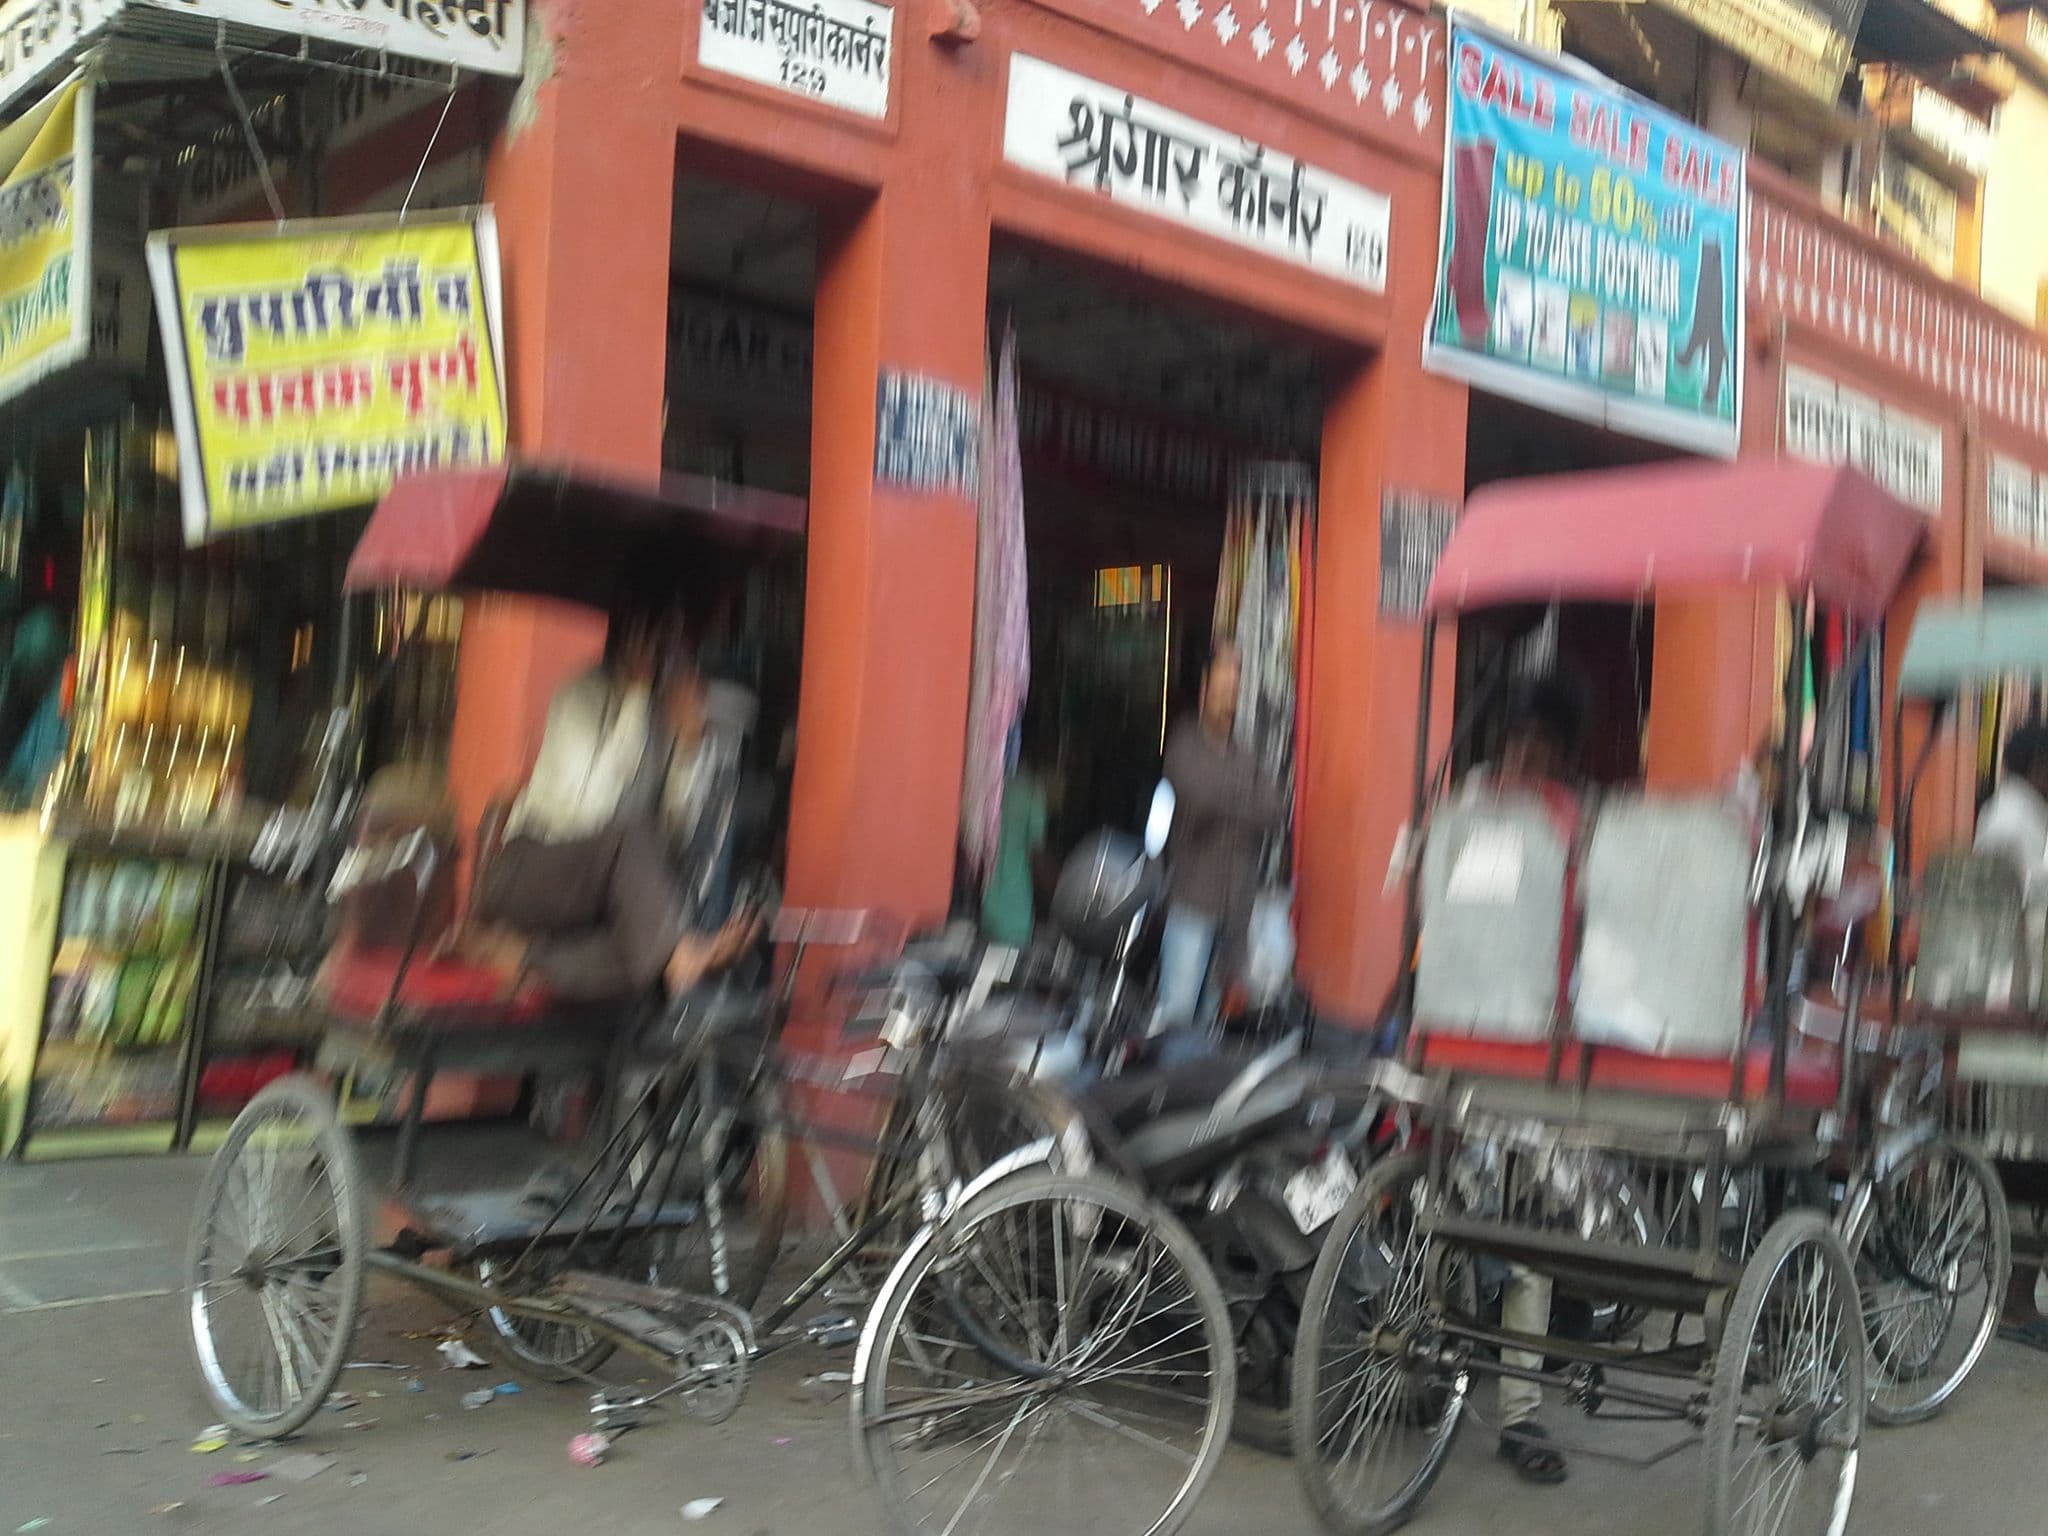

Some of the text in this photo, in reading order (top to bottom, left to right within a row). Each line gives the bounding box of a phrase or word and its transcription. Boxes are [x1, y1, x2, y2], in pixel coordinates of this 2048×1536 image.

[1457, 44, 1739, 212] SALE SALE SALE
[1505, 154, 1545, 200] up
[1553, 162, 1581, 213] to
[1495, 188, 1681, 322] UP TO DATE FOOTWEAR
